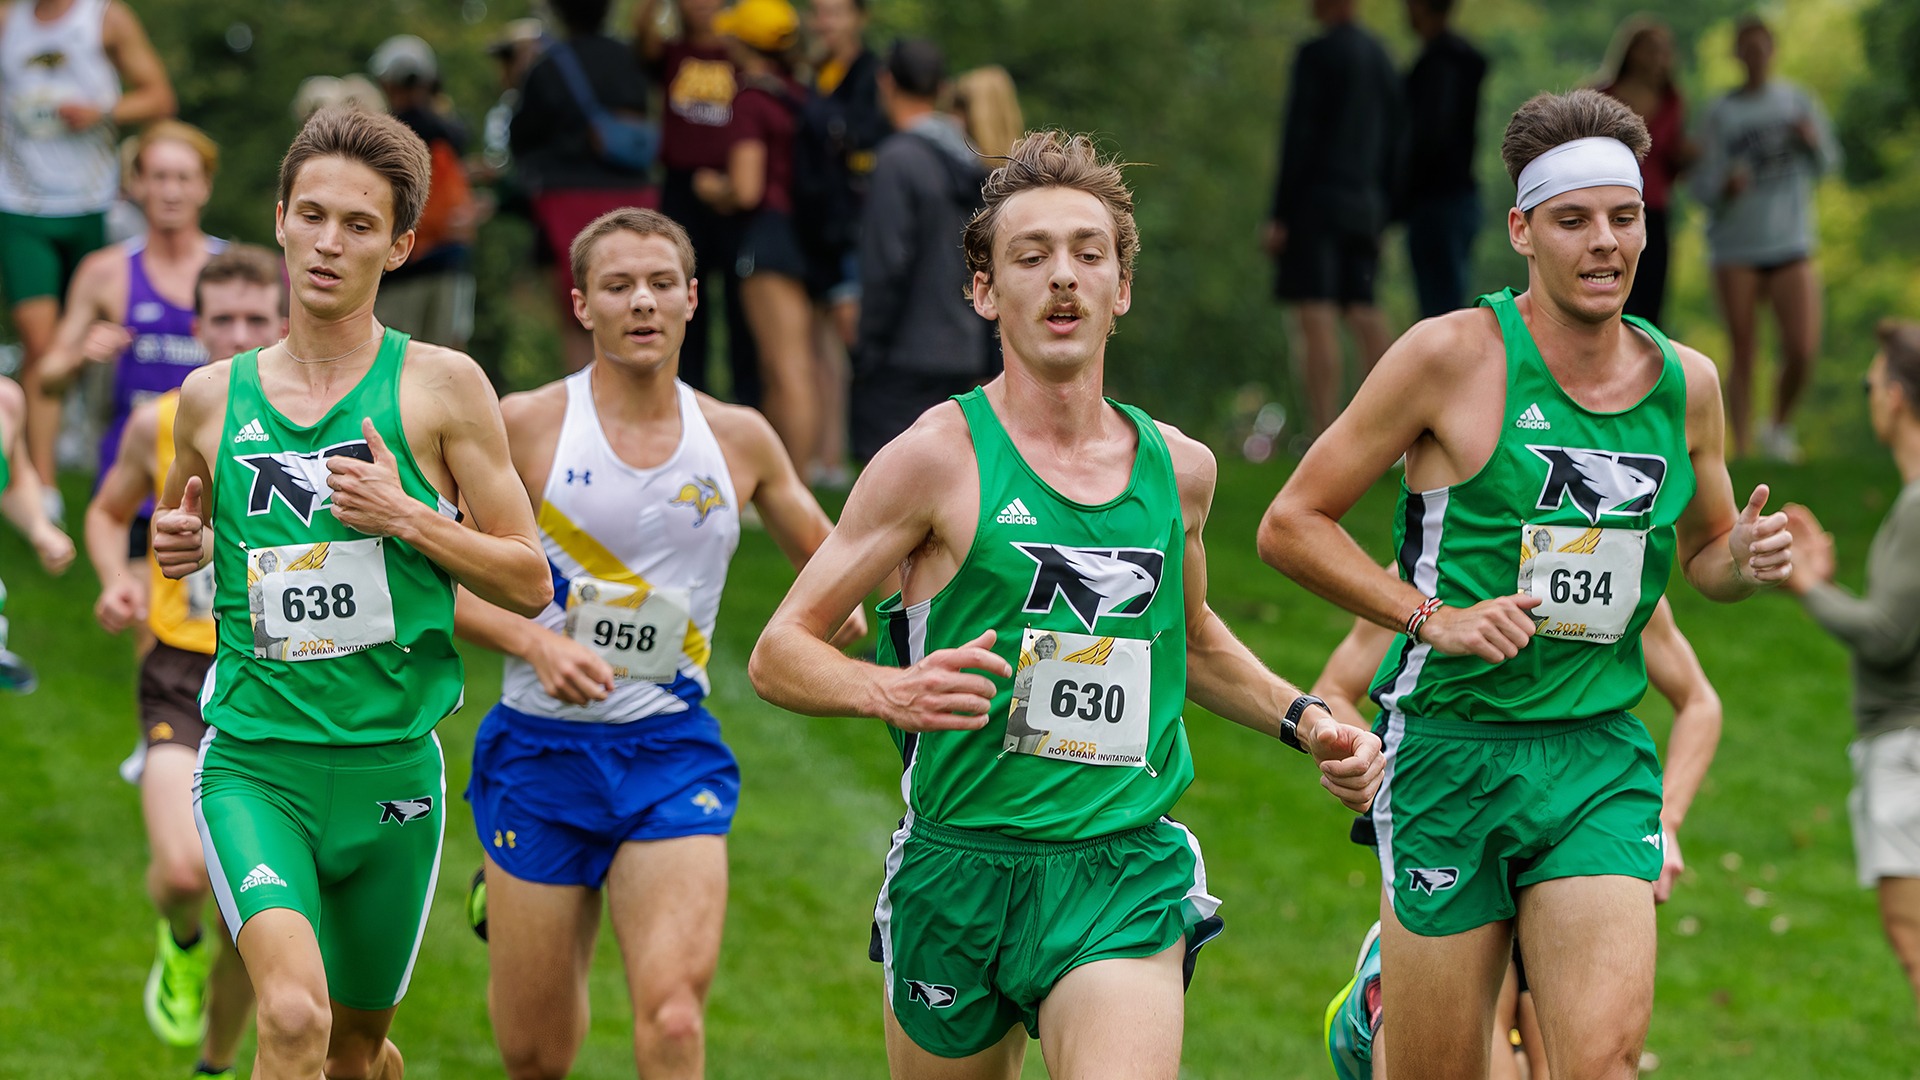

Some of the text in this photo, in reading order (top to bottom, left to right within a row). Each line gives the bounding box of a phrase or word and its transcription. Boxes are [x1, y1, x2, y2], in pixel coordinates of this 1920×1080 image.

[1516, 420, 1550, 430] adidas
[234, 432, 269, 443] adidas
[997, 513, 1037, 525] adidas
[1550, 568, 1612, 605] 634
[282, 583, 356, 623] 638
[594, 619, 656, 651] 958
[299, 639, 335, 652] 2025
[292, 649, 309, 657] ROY
[1050, 679, 1125, 723] 630
[1048, 746, 1067, 757] ROY
[1058, 739, 1097, 753] 2025
